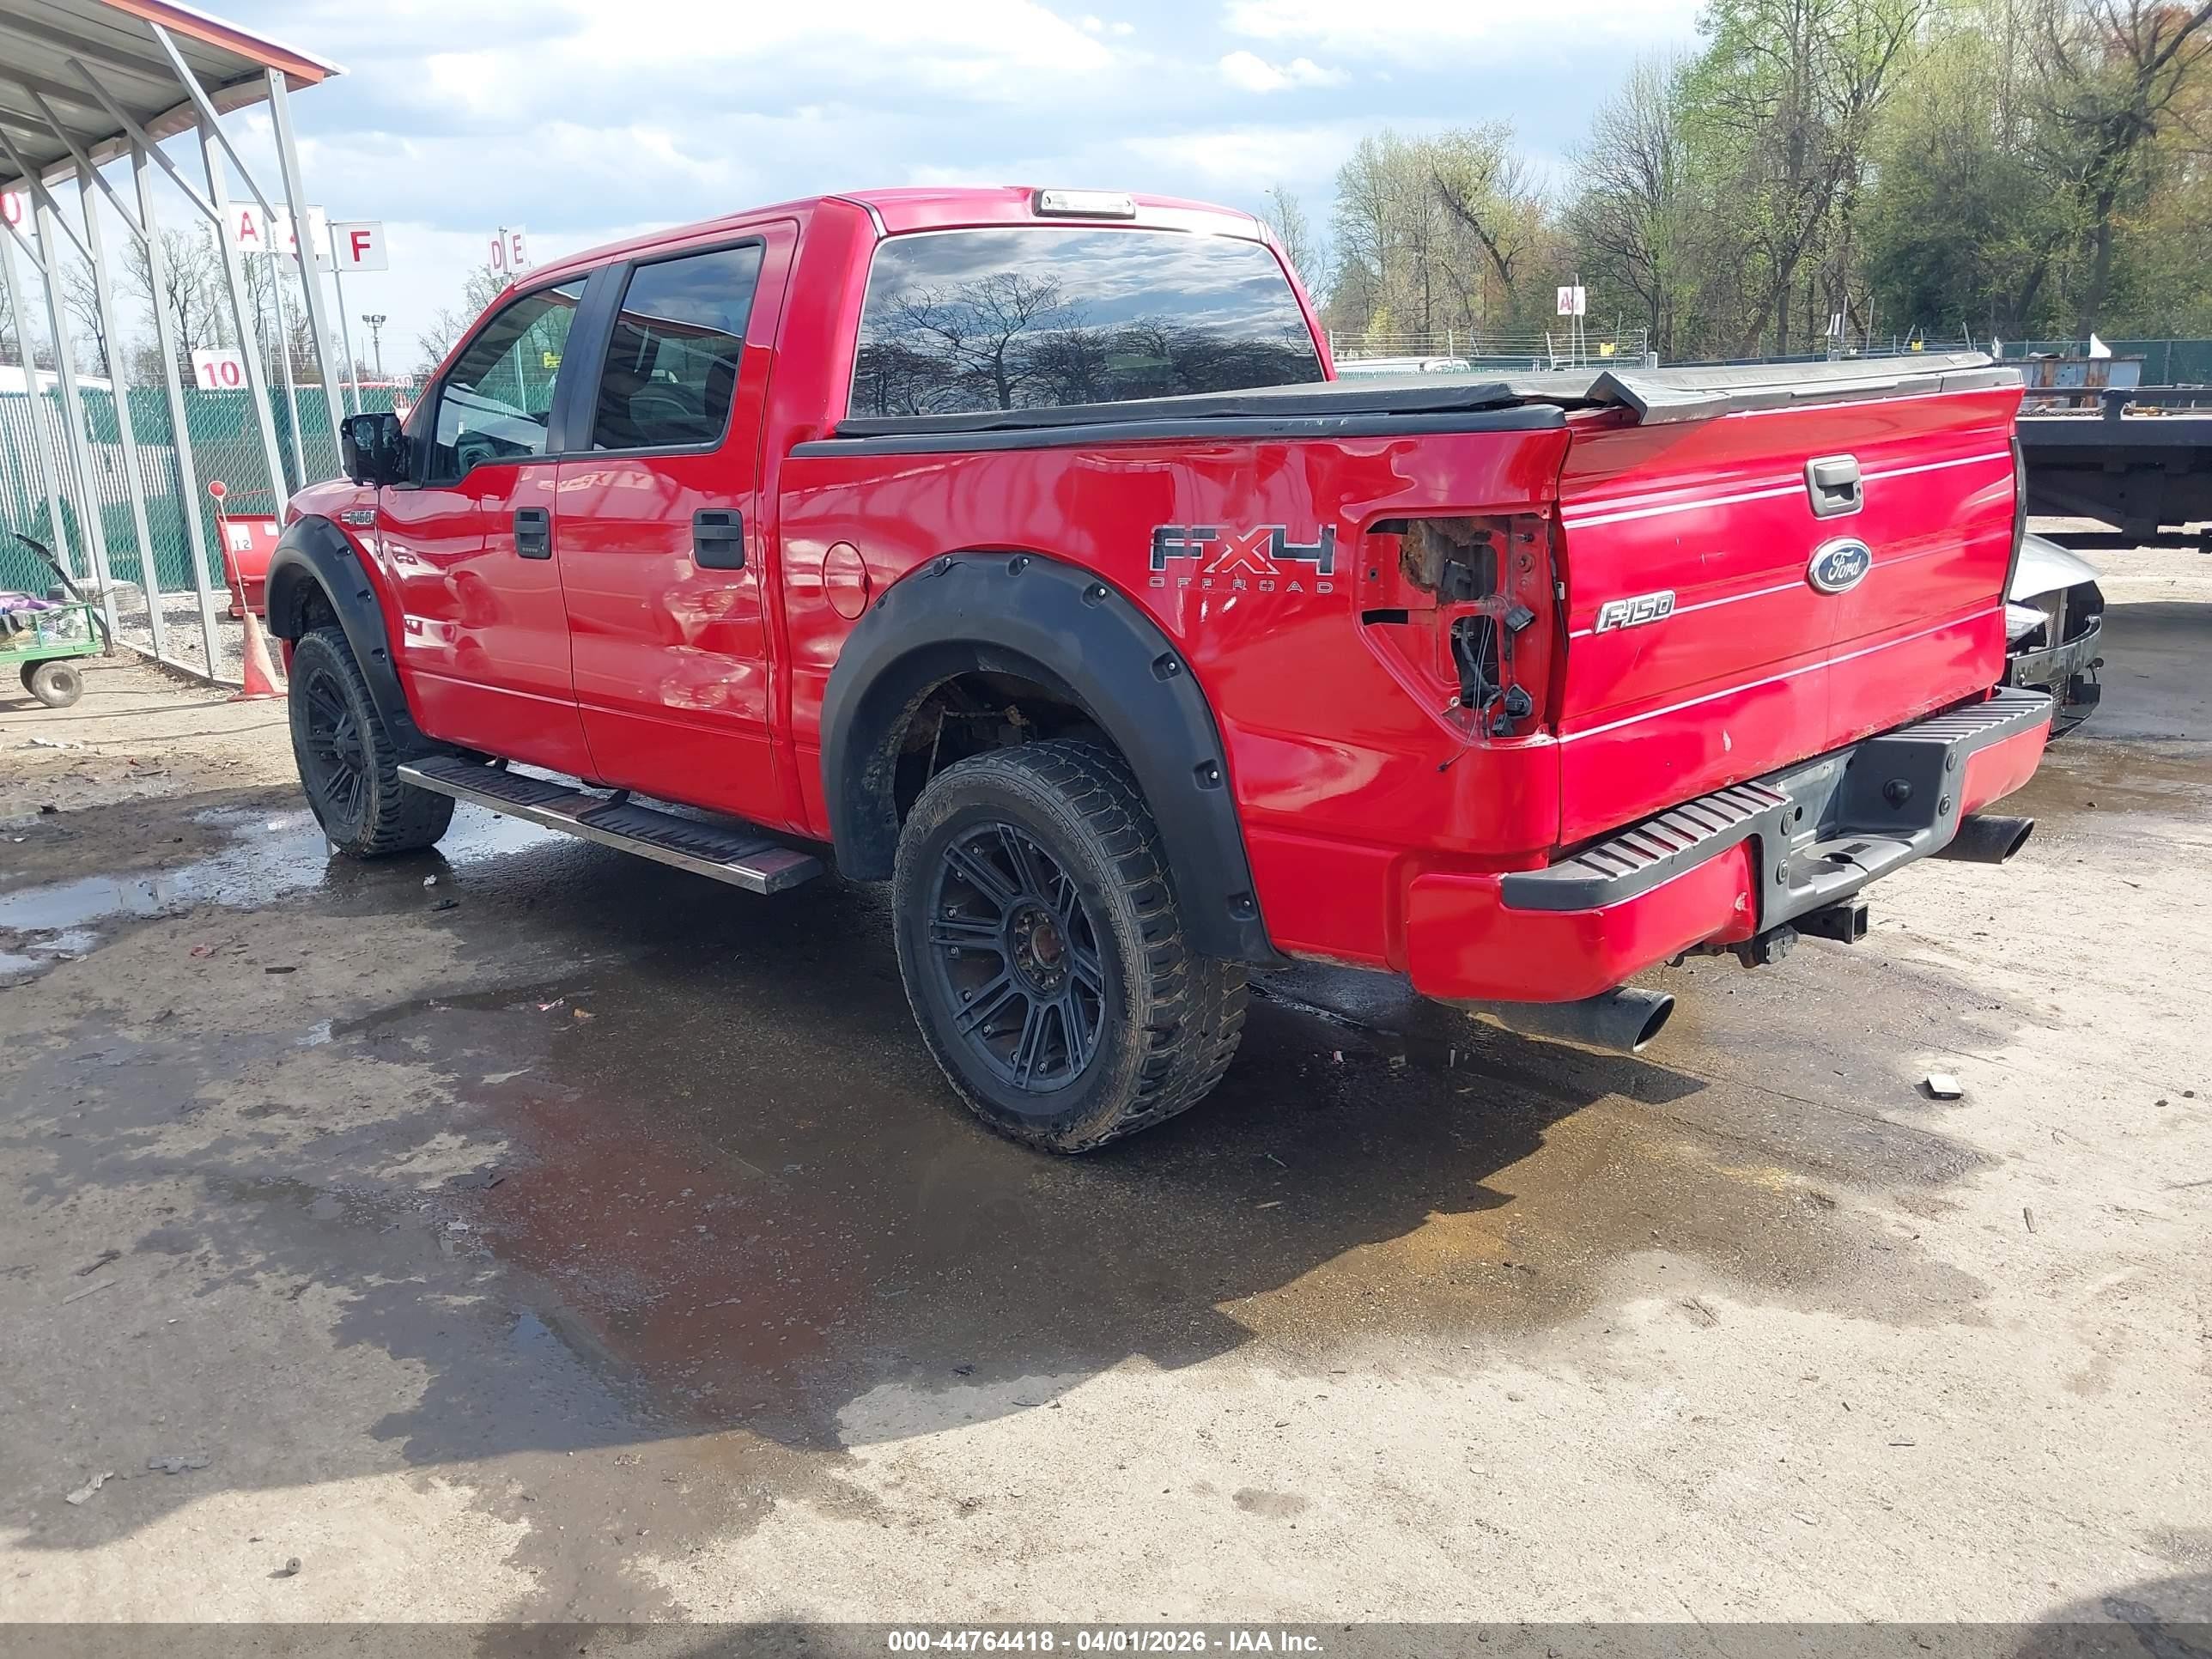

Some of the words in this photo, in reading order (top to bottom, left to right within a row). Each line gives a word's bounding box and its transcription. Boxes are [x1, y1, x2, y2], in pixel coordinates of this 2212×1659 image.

[236, 211, 258, 242] A
[350, 231, 371, 262] F
[491, 240, 502, 270] D
[512, 234, 524, 264] E
[1559, 290, 1571, 310] A
[202, 361, 240, 387] 10
[1149, 524, 1337, 576] FX4
[1827, 550, 1862, 581] Ford
[1149, 576, 1216, 590] OFF
[1231, 578, 1334, 593] ROAD
